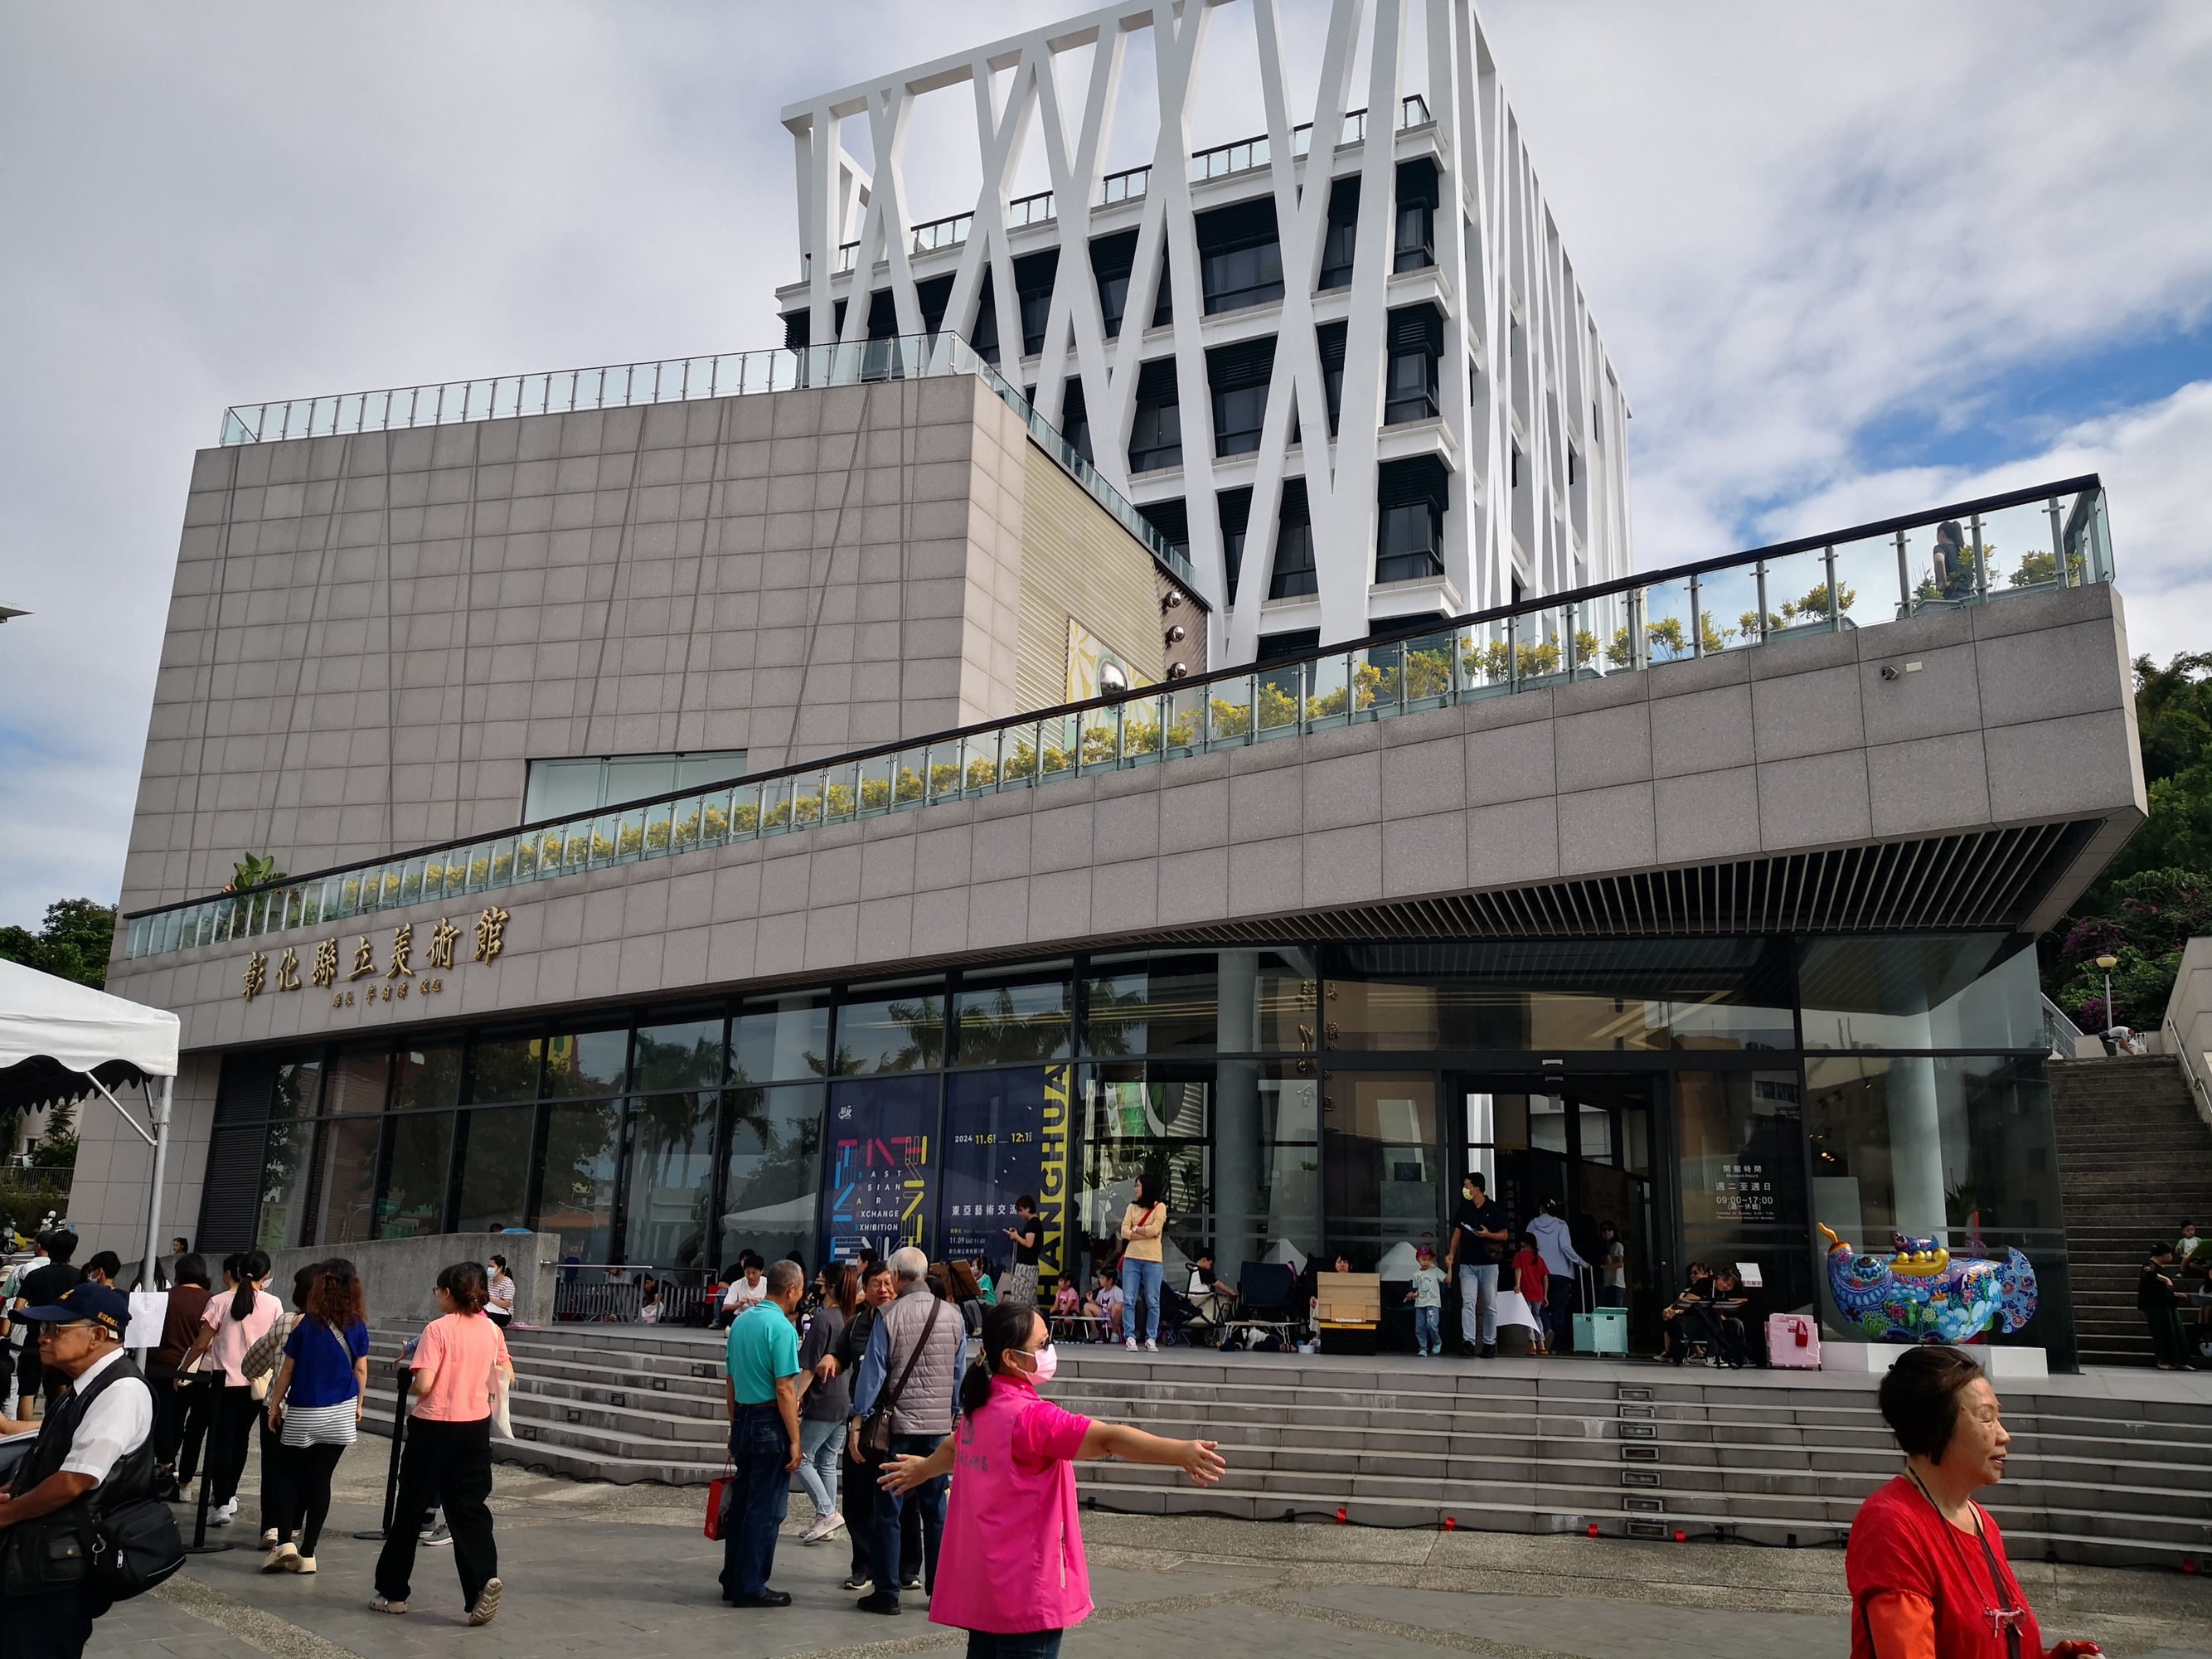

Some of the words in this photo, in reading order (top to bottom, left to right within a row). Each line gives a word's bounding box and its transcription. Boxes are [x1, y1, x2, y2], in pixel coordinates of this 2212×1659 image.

[242, 906, 510, 1002] 彰化縣立美術館
[975, 1134, 993, 1144] 11.6
[859, 1170, 901, 1178] EAST
[1715, 1181, 1771, 1191] 週二至週日
[952, 1204, 1017, 1216] 東亞藝術交流
